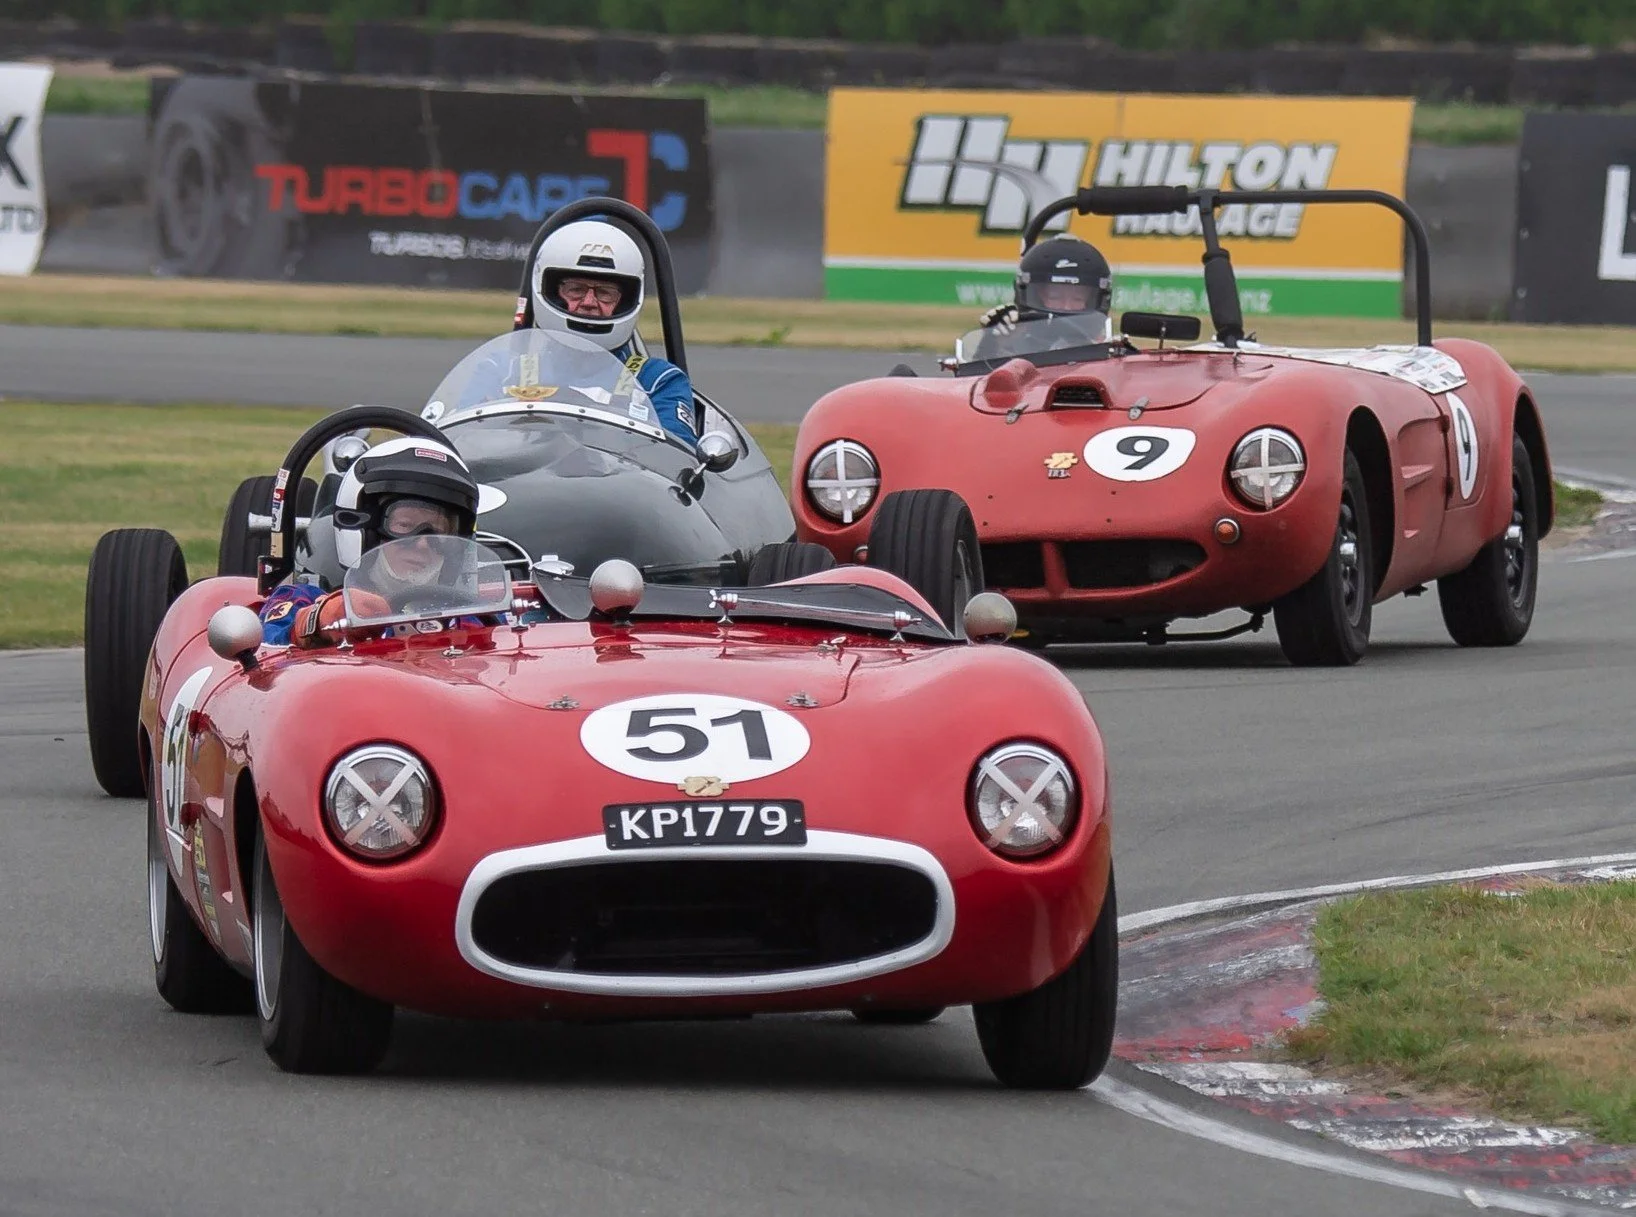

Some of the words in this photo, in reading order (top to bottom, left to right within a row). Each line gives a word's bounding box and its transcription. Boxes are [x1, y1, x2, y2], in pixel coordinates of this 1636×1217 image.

[1094, 138, 1337, 192] HILTON
[1112, 203, 1306, 240] HAUAGE
[1116, 435, 1170, 471] 9
[1456, 406, 1472, 482] 9
[625, 707, 773, 762] 51
[620, 805, 788, 841] KP1779
